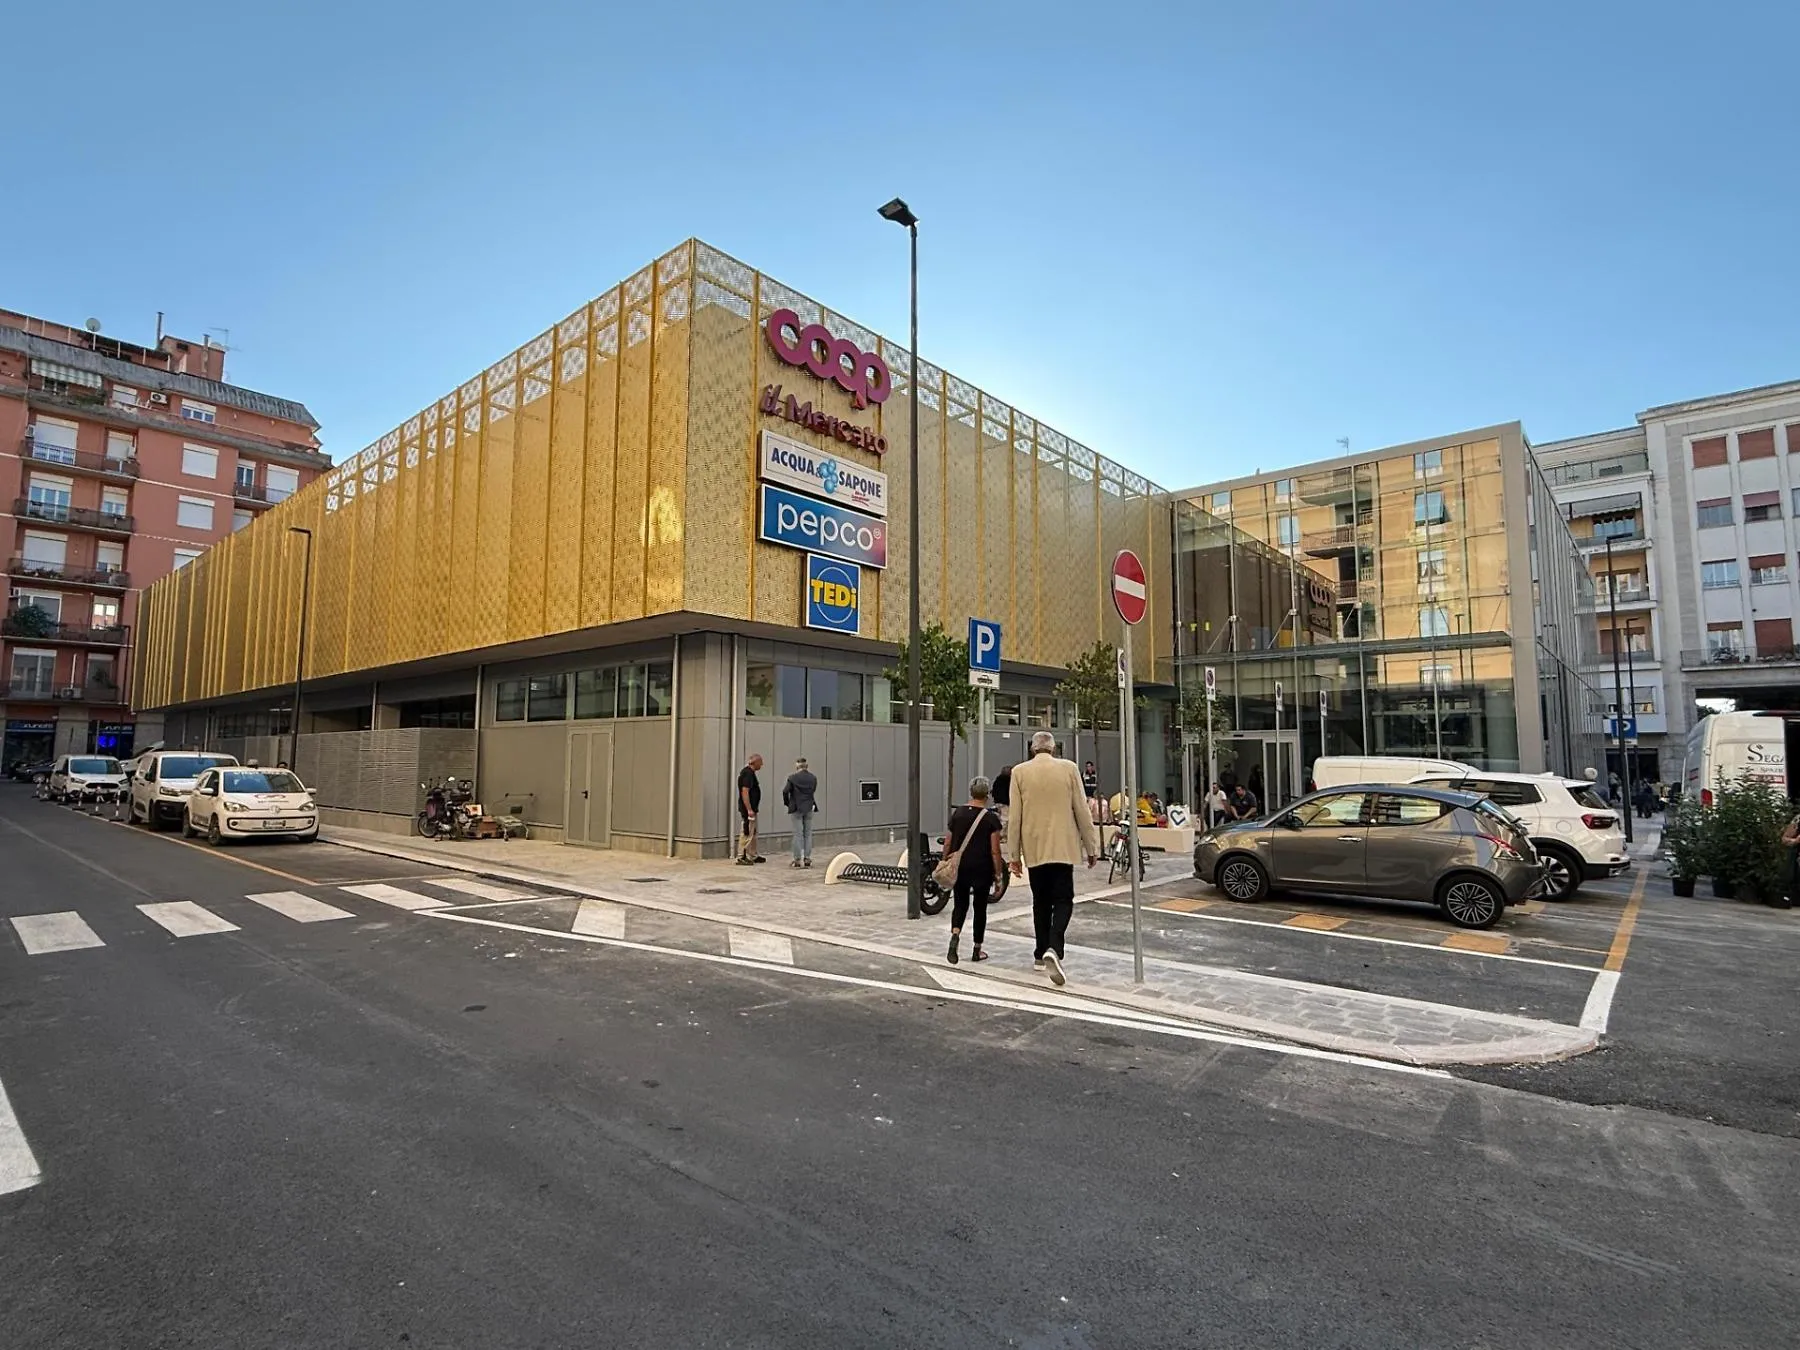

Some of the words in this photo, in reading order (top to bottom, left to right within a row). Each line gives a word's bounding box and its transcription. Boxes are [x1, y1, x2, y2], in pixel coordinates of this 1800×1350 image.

[767, 308, 891, 410] coop
[786, 394, 888, 455] Mercato
[771, 447, 815, 474] ACQUA
[838, 471, 882, 499] SAPONE
[976, 624, 995, 664] P
